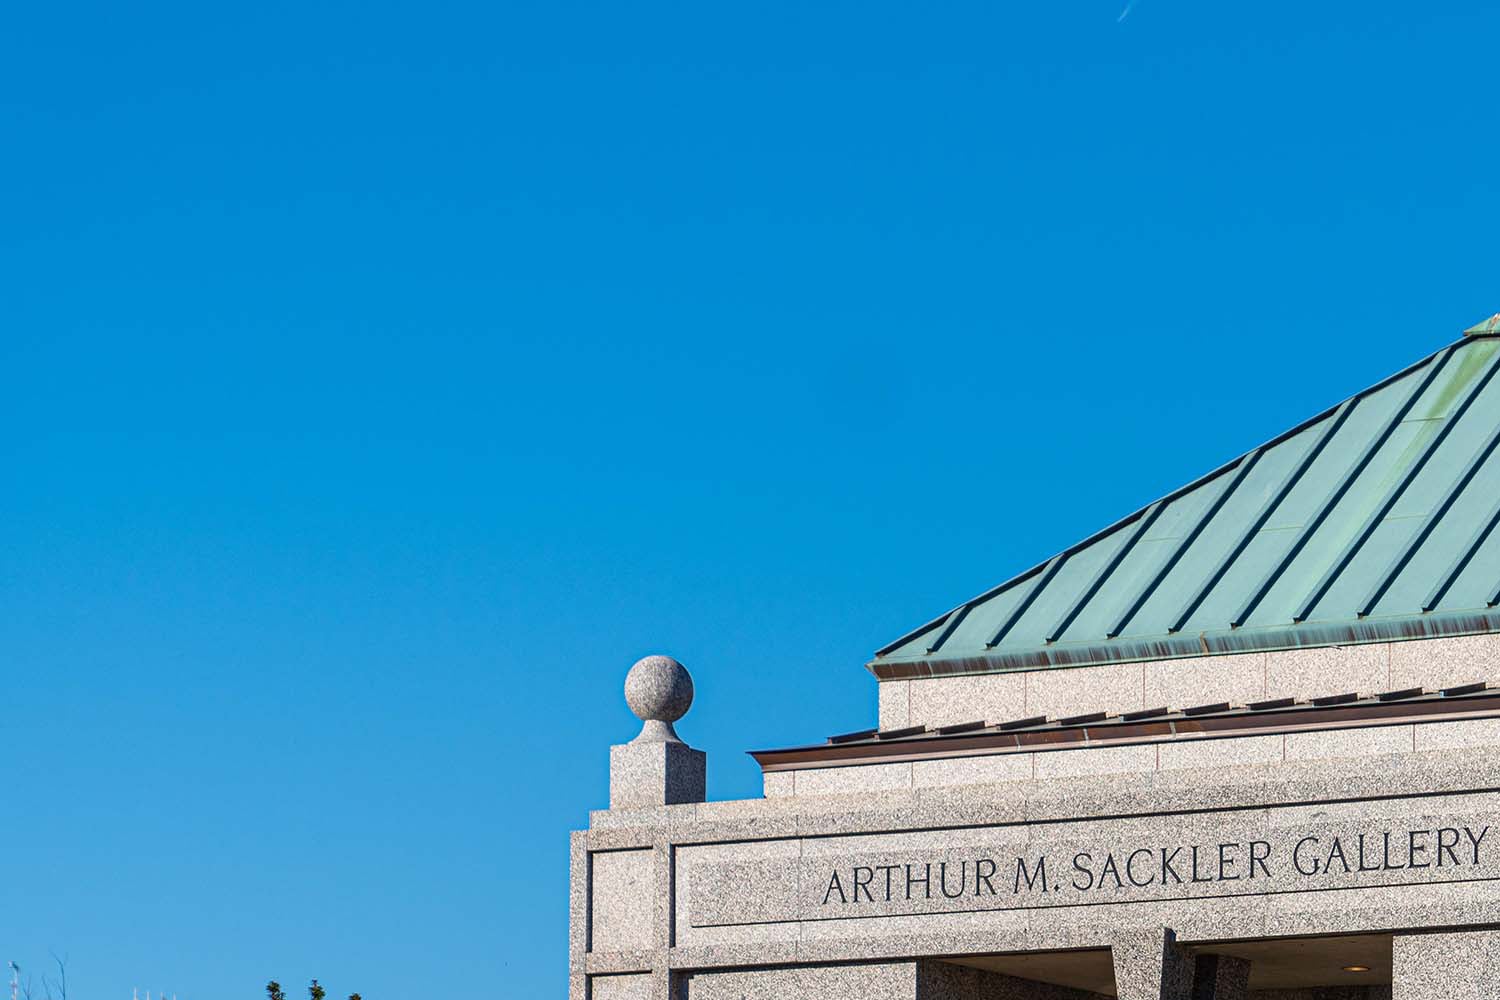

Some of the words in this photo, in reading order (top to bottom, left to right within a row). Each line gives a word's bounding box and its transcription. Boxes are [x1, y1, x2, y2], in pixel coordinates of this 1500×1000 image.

[822, 858, 998, 905] ARTHUR
[1012, 856, 1062, 894] M.
[1072, 840, 1272, 891] SACKLER
[1292, 826, 1491, 877] GALLERY
